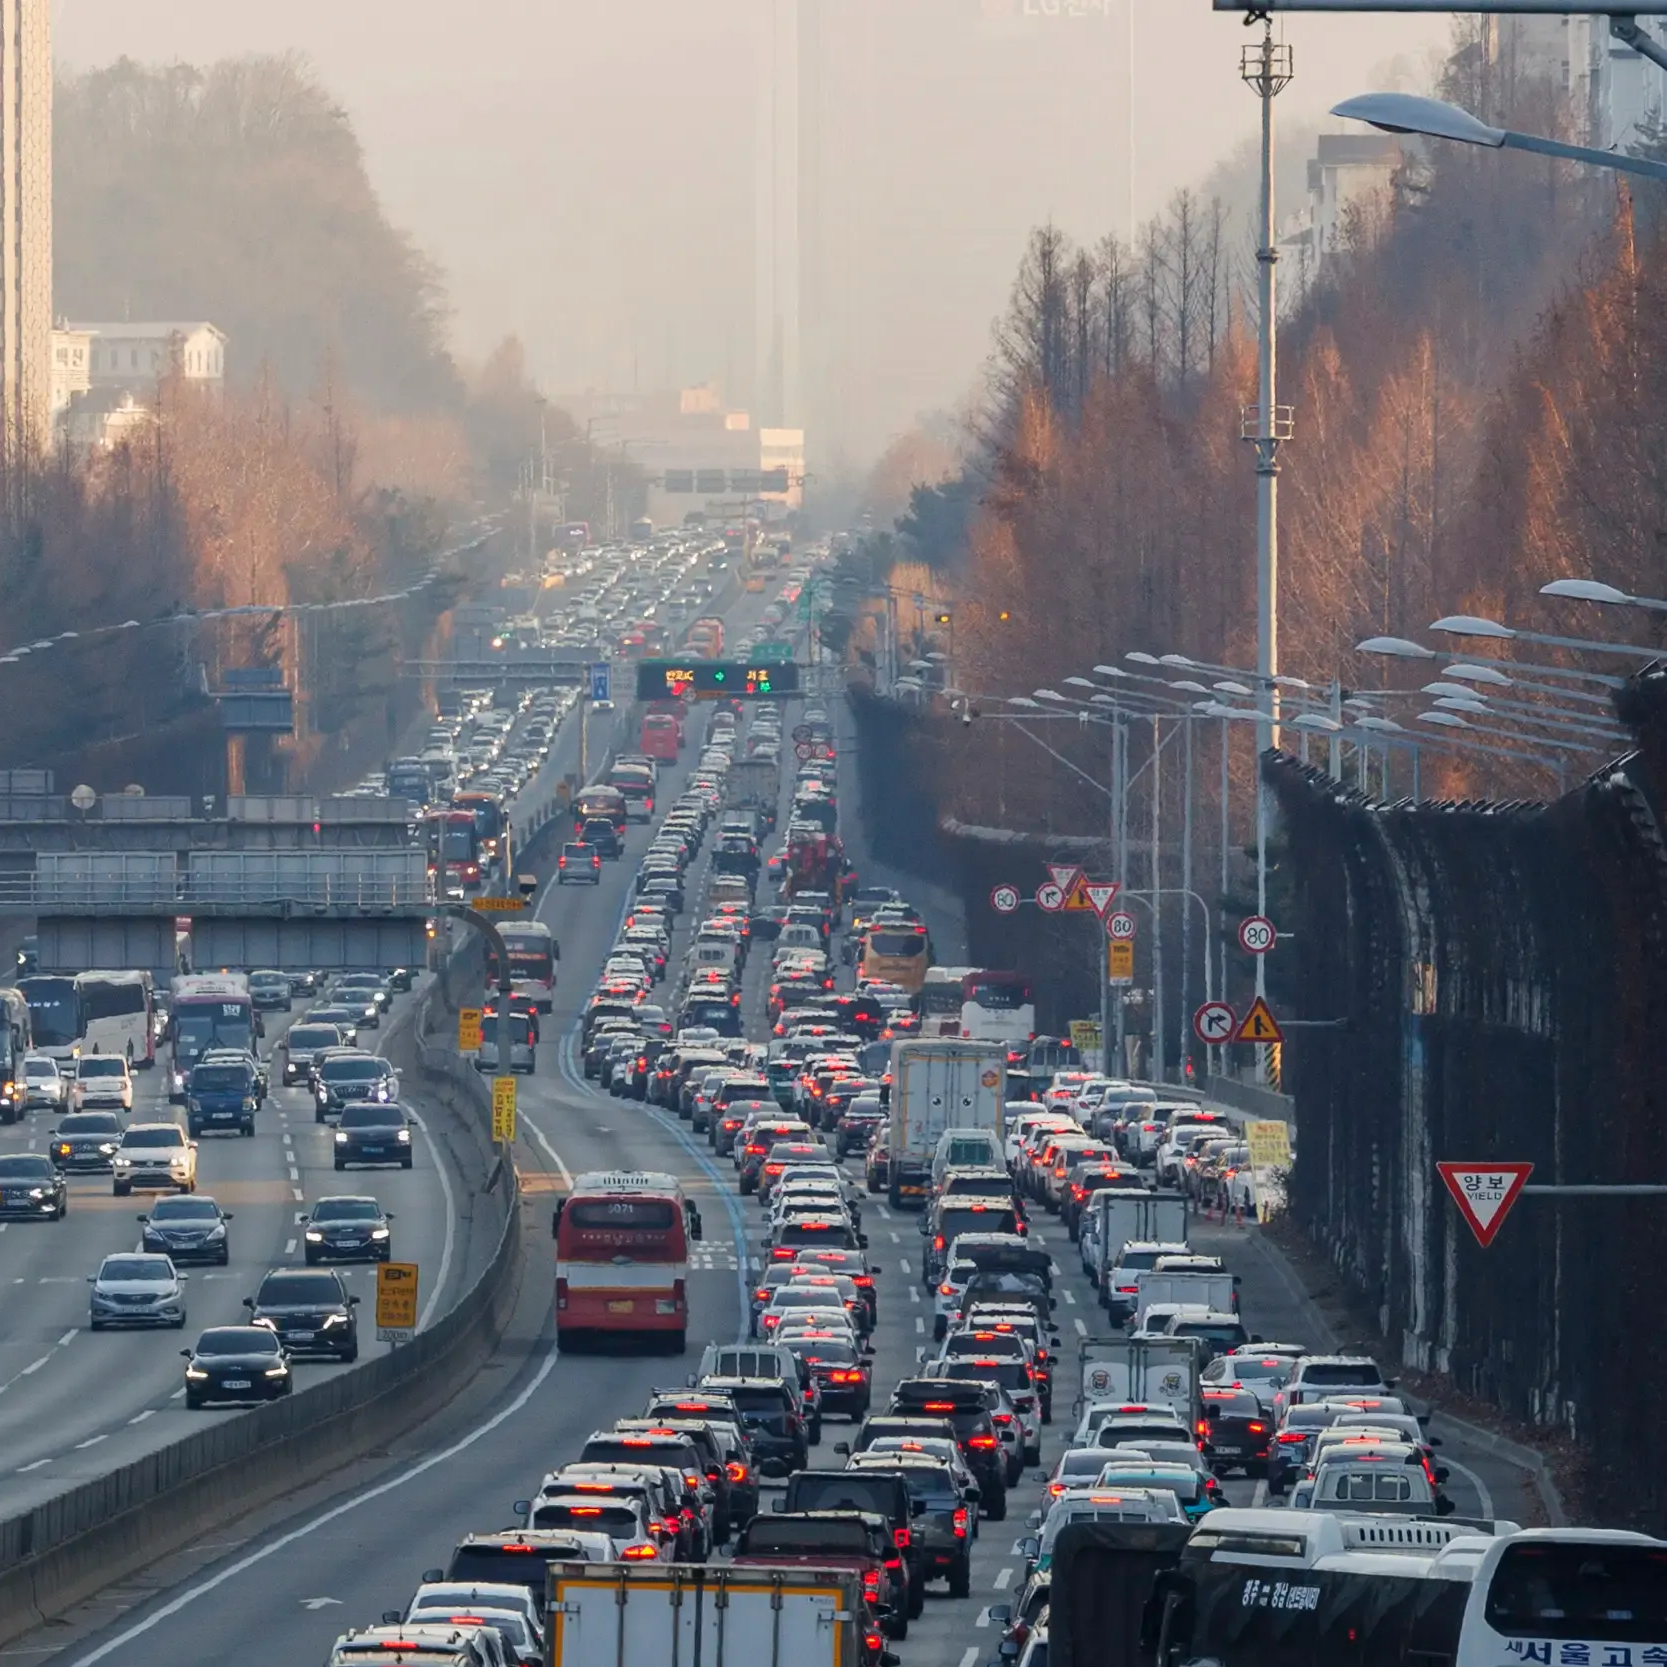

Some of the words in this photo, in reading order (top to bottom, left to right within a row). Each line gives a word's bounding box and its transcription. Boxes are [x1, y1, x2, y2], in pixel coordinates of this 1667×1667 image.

[996, 892, 1014, 907] 80
[1113, 919, 1132, 933] 80
[1247, 927, 1270, 945] 80
[1463, 1174, 1506, 1191] 양보
[1466, 1191, 1503, 1201] YIELD
